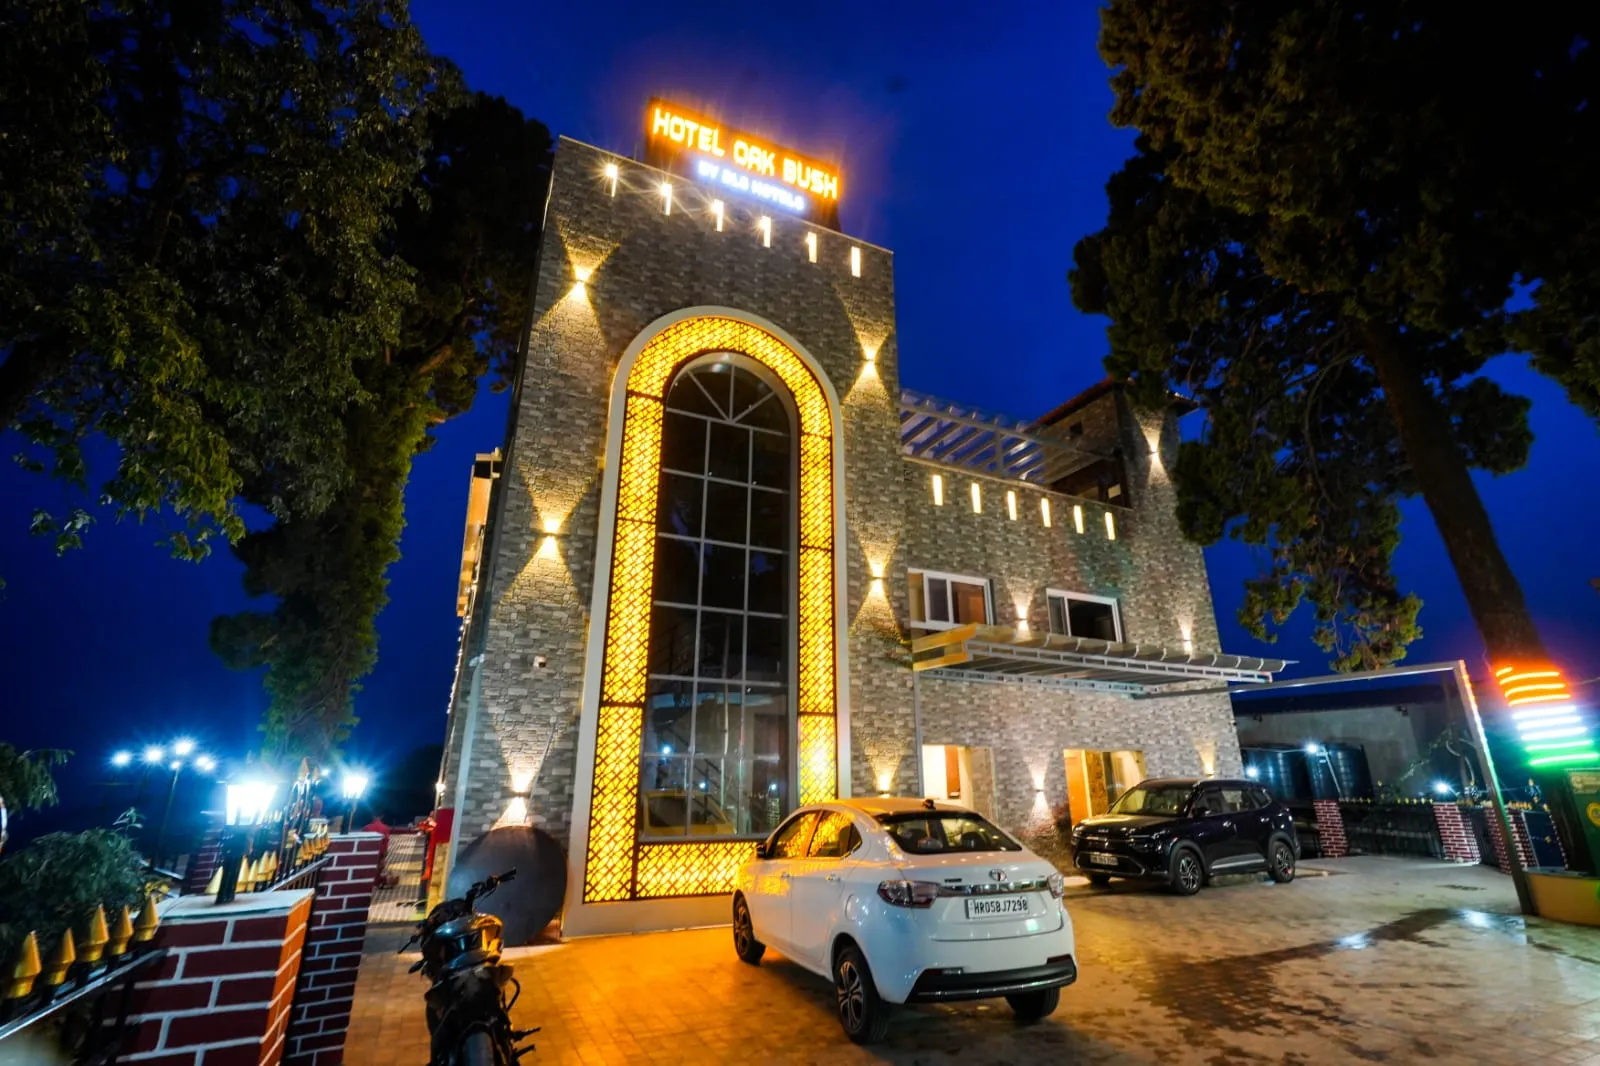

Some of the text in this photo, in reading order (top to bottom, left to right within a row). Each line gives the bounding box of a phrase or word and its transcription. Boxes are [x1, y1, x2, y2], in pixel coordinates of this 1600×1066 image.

[653, 107, 837, 200] HOTEL OAK BUSH
